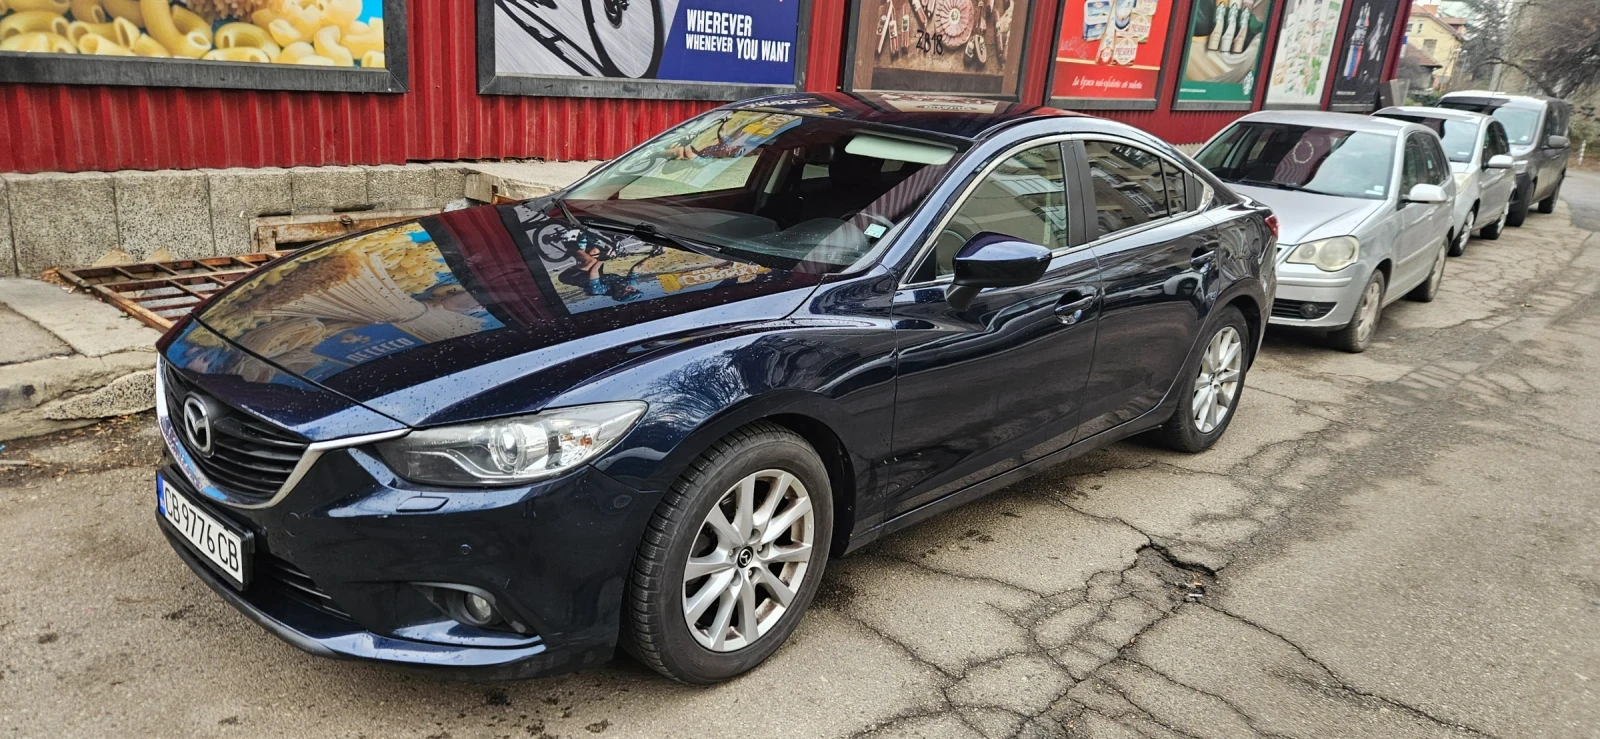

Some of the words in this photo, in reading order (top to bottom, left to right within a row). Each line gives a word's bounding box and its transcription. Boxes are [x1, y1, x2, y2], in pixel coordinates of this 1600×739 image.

[686, 9, 753, 37] WHEREVER
[686, 33, 733, 53] WHENEVER
[736, 38, 759, 60] YOU
[761, 41, 791, 63] WANT
